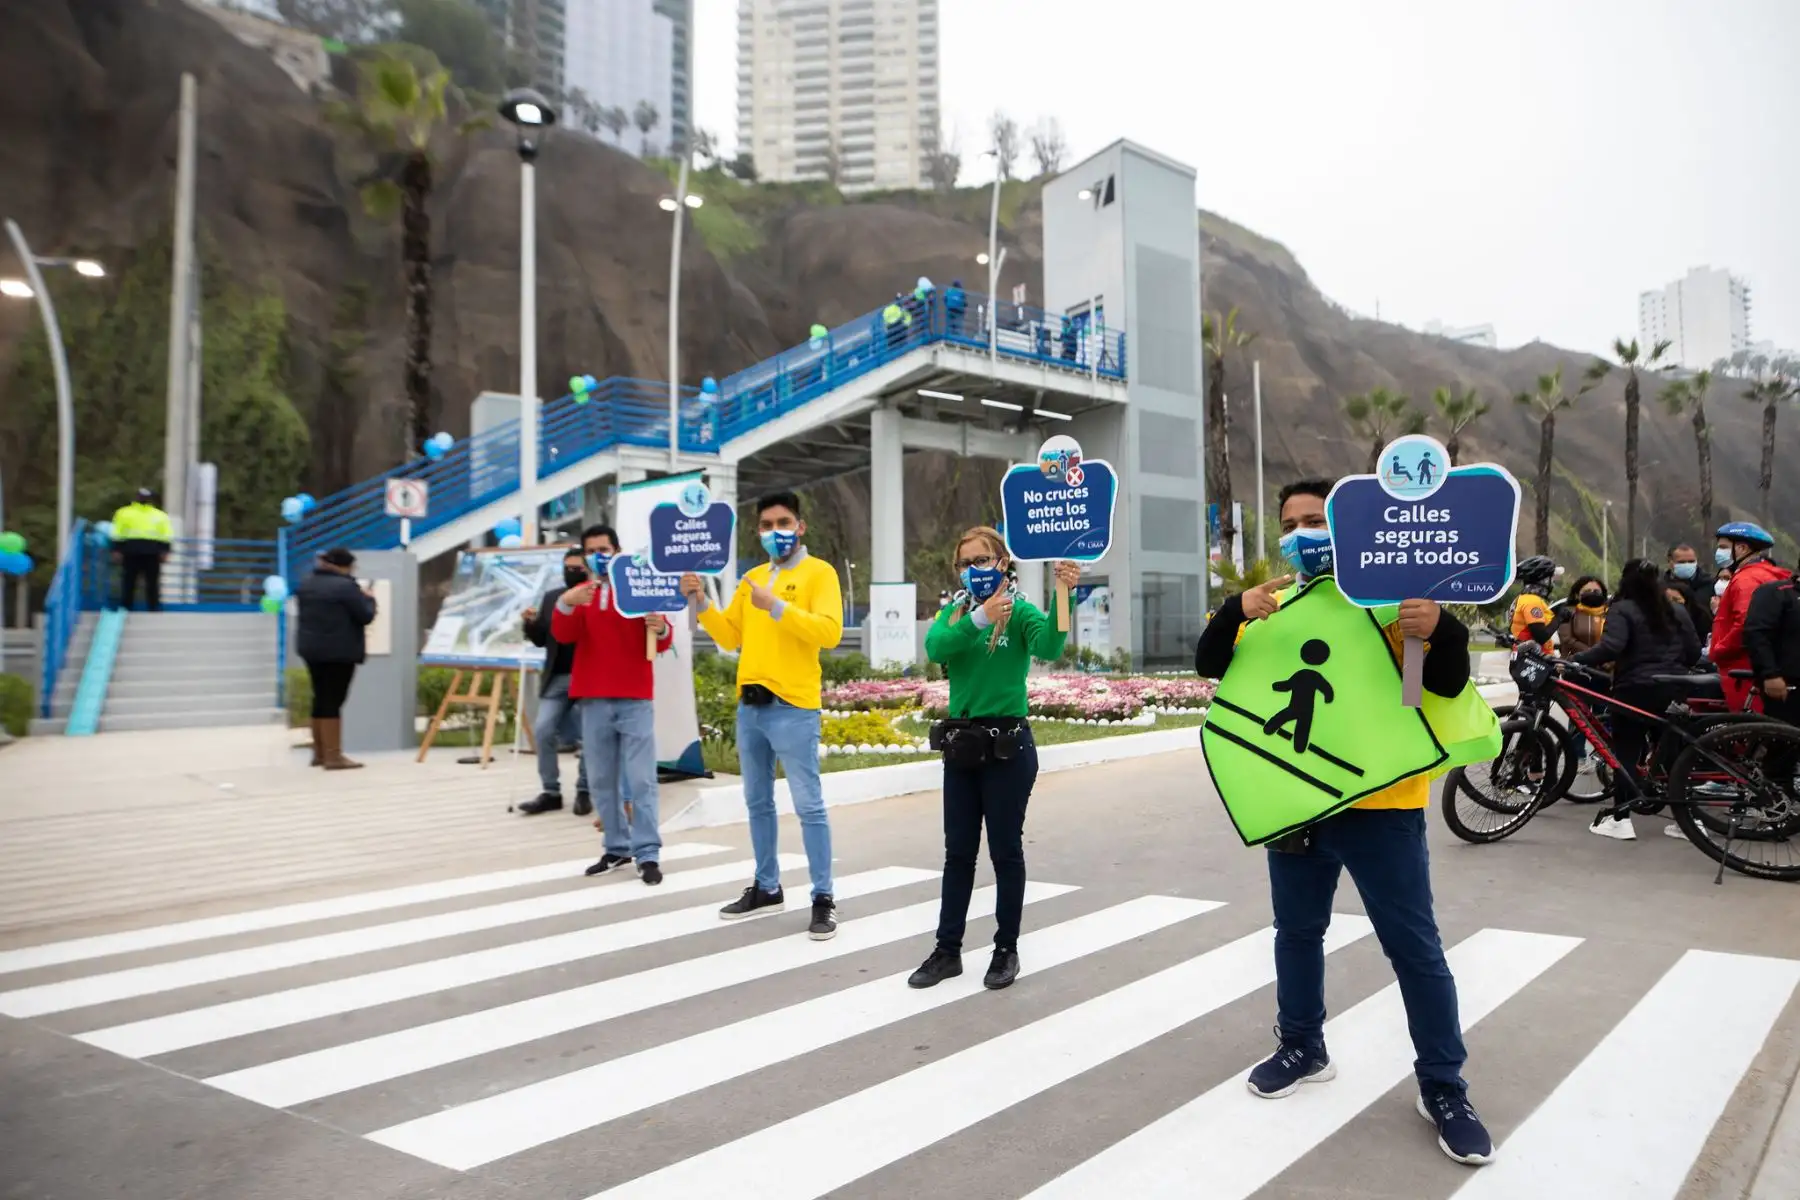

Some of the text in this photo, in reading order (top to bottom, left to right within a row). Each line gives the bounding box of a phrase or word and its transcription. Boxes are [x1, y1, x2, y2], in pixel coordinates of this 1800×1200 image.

[1023, 487, 1089, 504] No cruces
[1028, 502, 1087, 519] entre los
[1383, 504, 1451, 523] Calles
[675, 519, 707, 531] Calles
[1026, 517, 1090, 535] vehículos
[671, 531, 712, 544] seguras
[1374, 529, 1459, 548] seguras
[664, 541, 721, 557] para todos
[1360, 547, 1480, 569] para todos
[625, 566, 651, 577] En la
[628, 576, 679, 587] baja de la
[1467, 584, 1494, 592] LIMA
[631, 586, 676, 597] bicicleta
